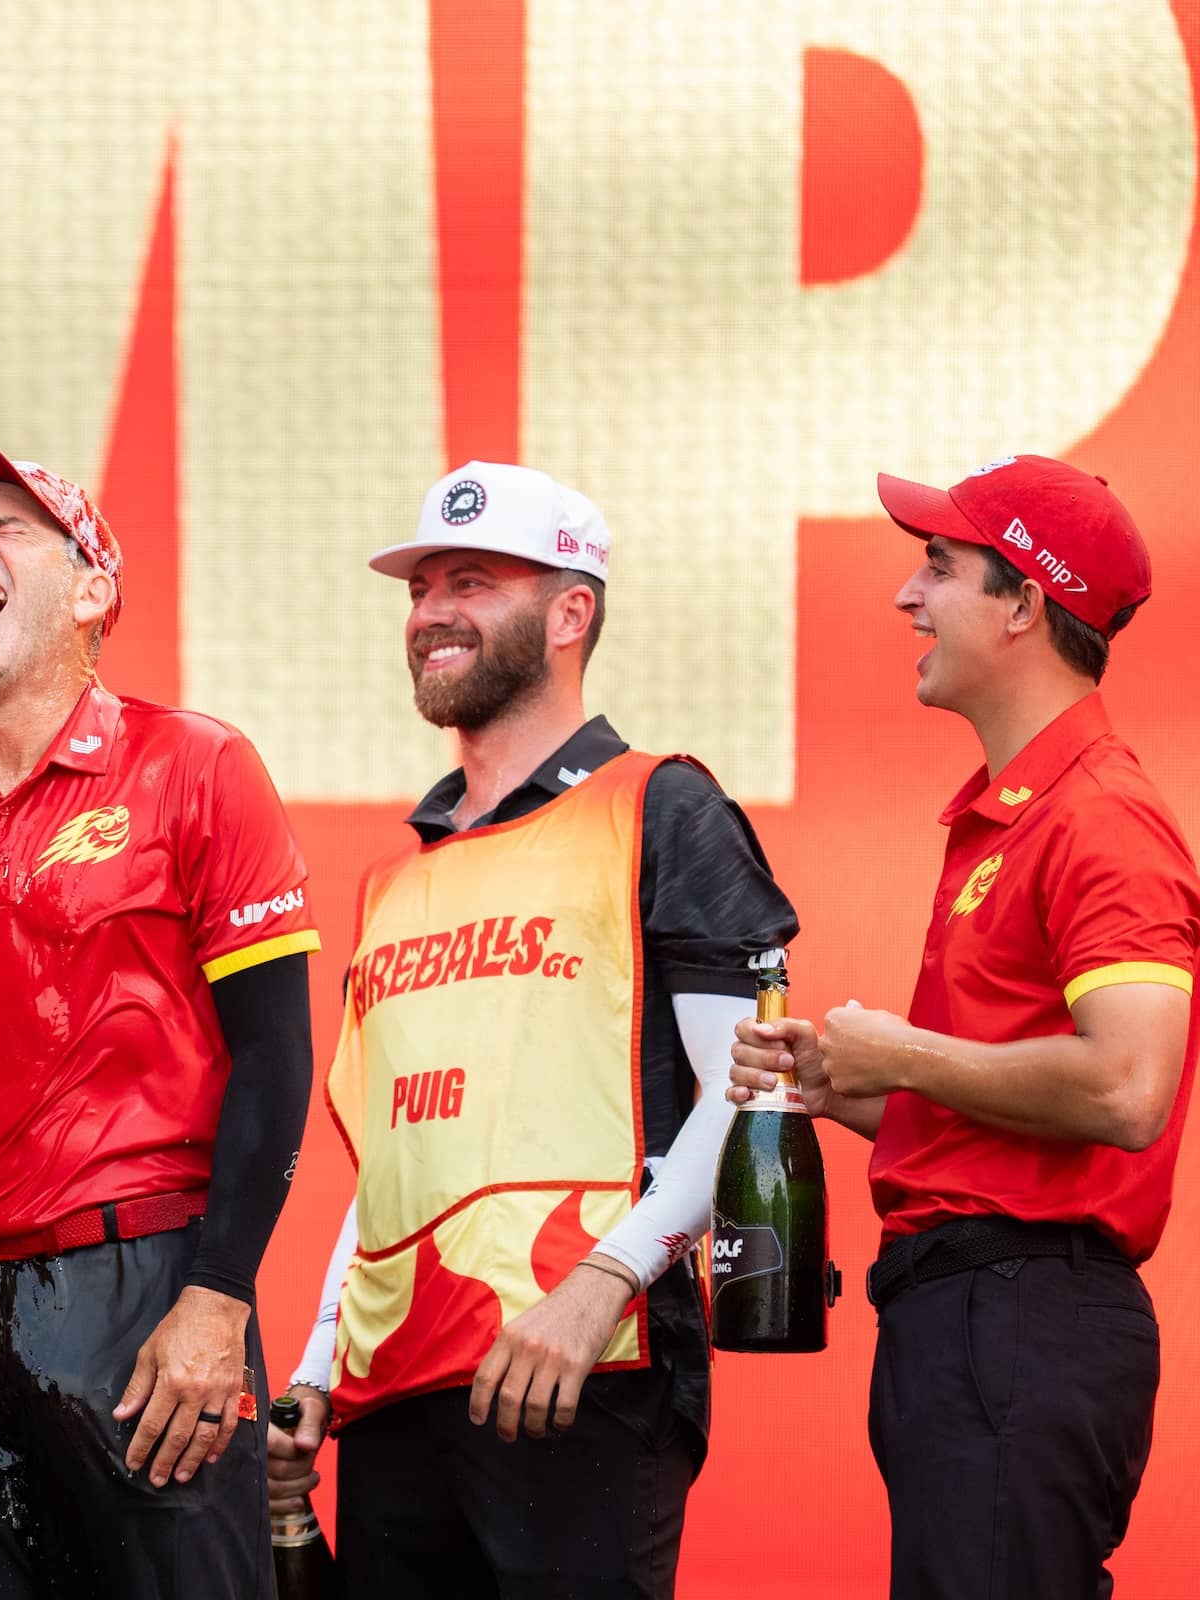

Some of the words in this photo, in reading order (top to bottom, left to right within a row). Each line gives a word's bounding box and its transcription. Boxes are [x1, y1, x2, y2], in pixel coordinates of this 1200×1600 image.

[1036, 549, 1072, 583] mip
[350, 916, 555, 1026] FIREBALLS
[541, 952, 583, 979] GC
[391, 1067, 465, 1129] PUIG
